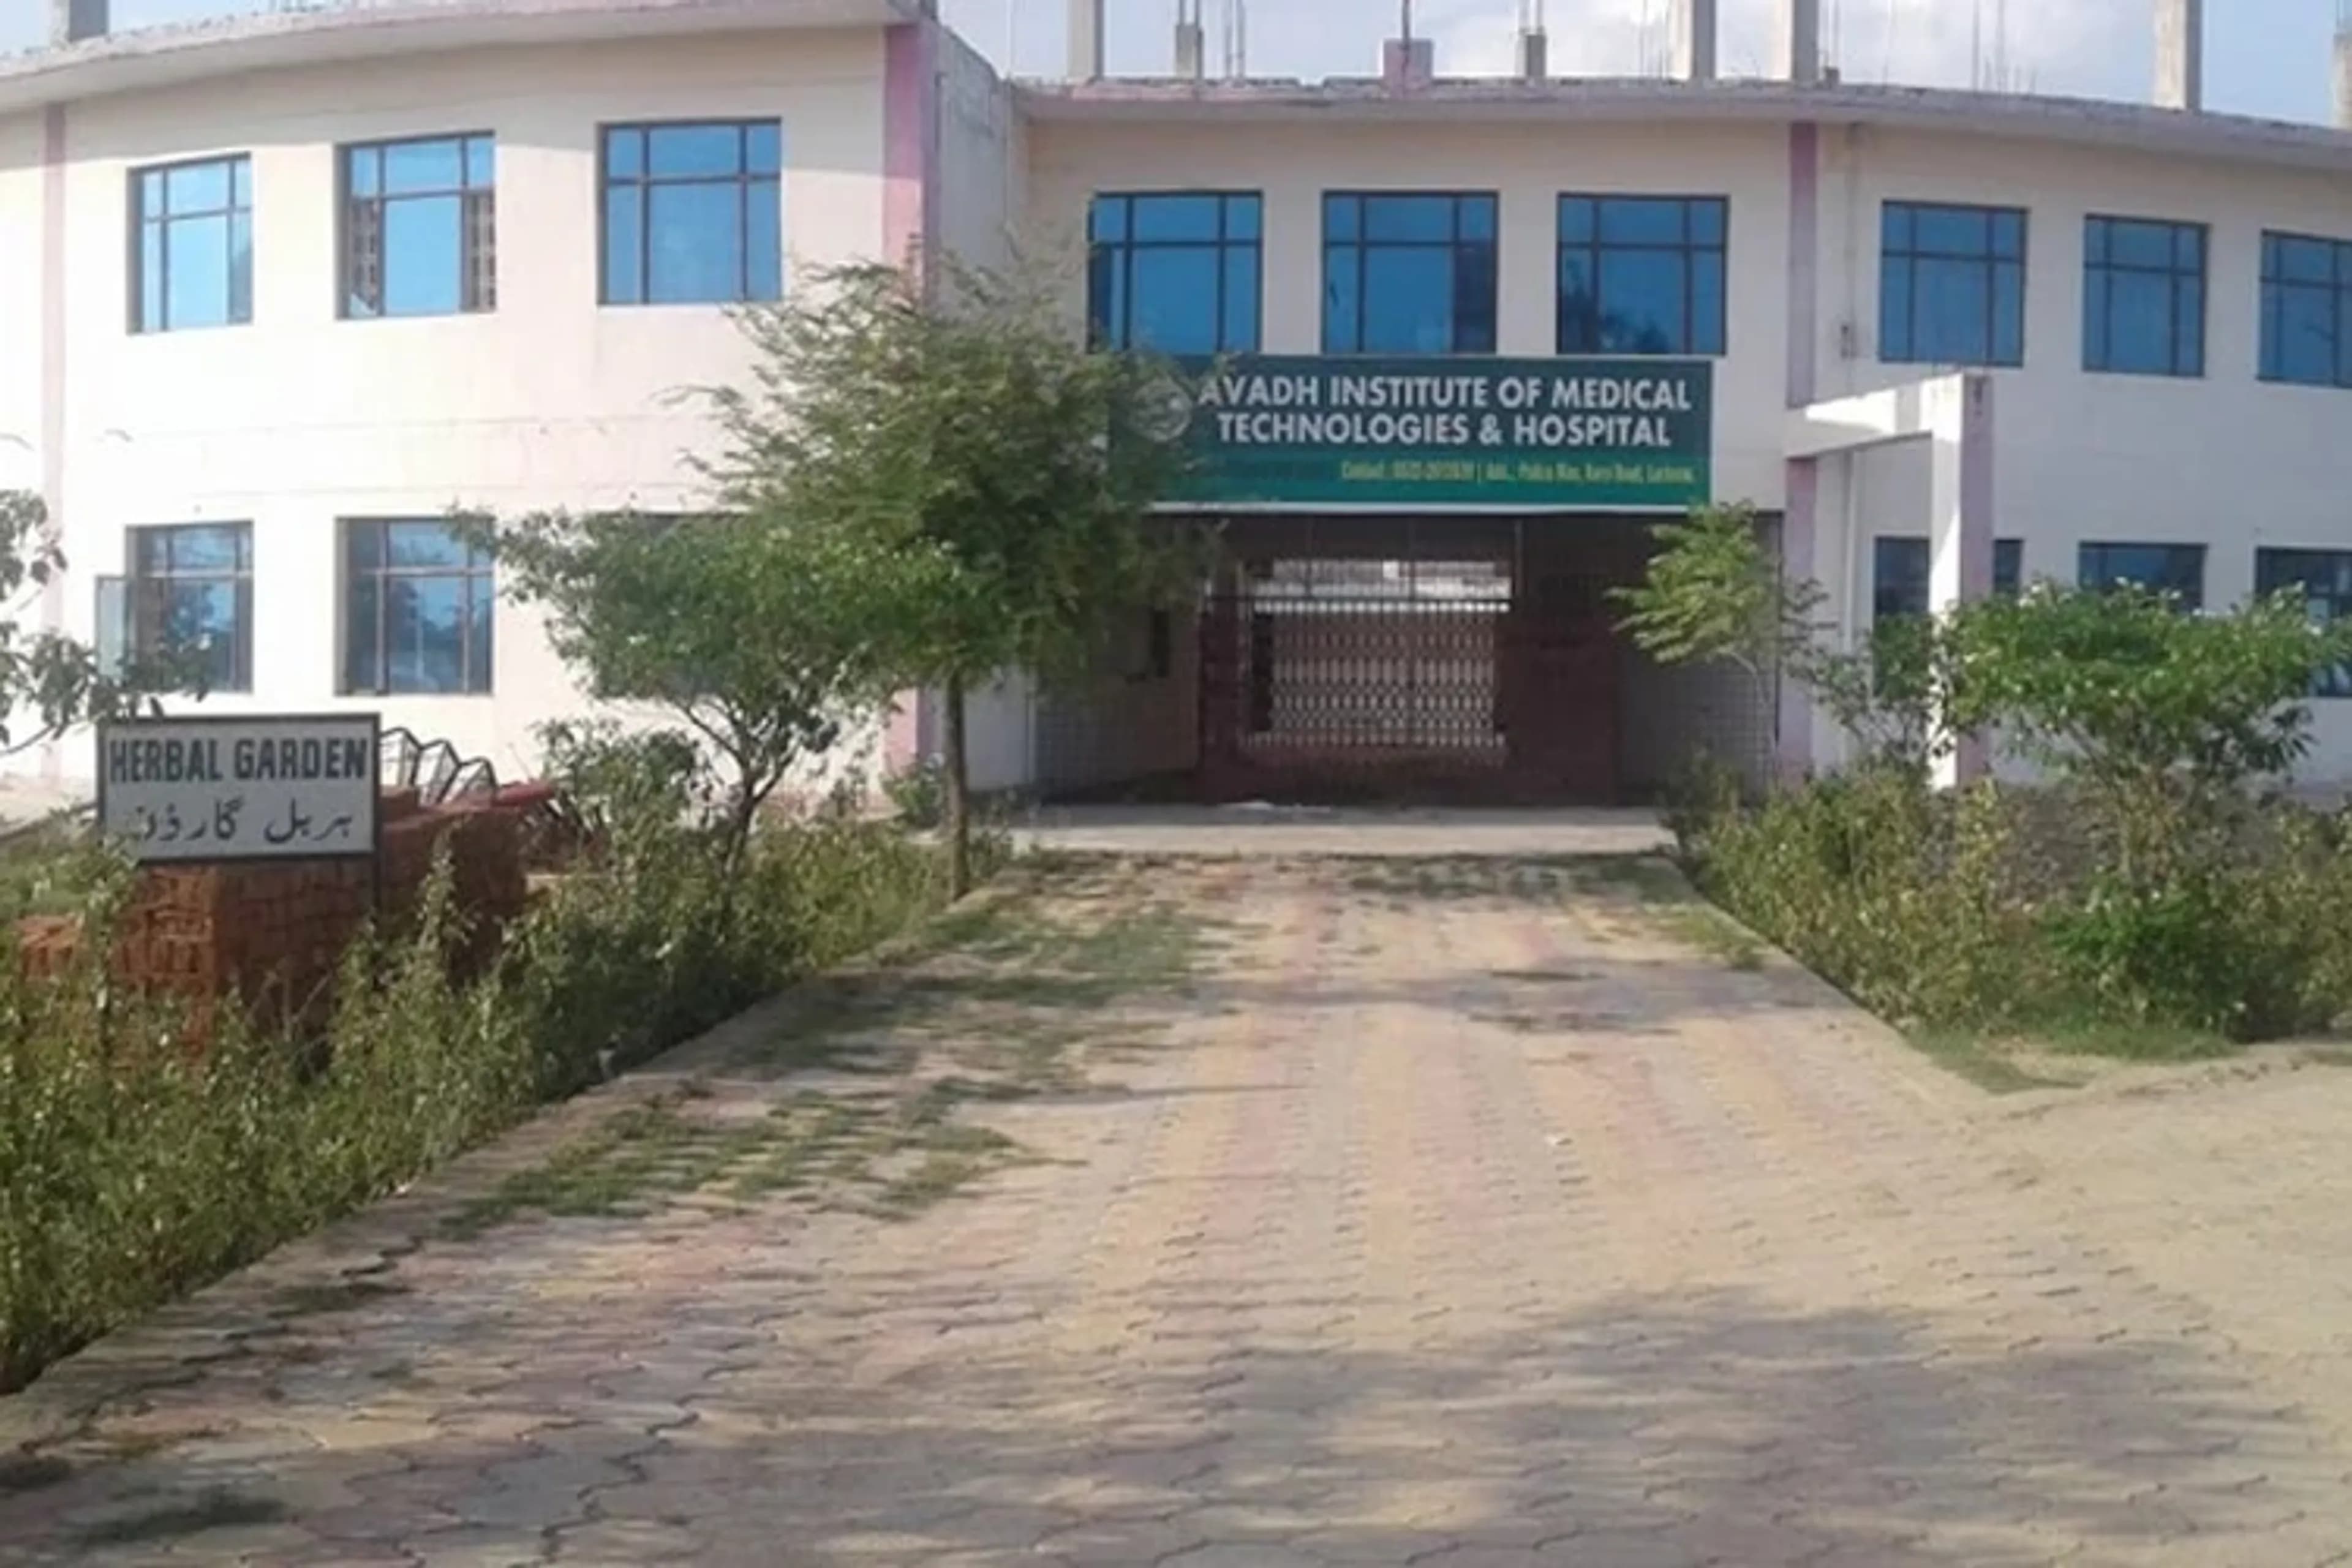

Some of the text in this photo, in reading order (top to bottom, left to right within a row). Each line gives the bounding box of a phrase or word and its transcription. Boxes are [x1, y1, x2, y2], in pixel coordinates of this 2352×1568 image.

[1198, 374, 1692, 410] AVADH INSTITUTE OF MEDICAL
[1217, 412, 1672, 447] TECHNOLOGIES & HOSPITAL
[109, 737, 367, 783] HERBAL GARDEN
